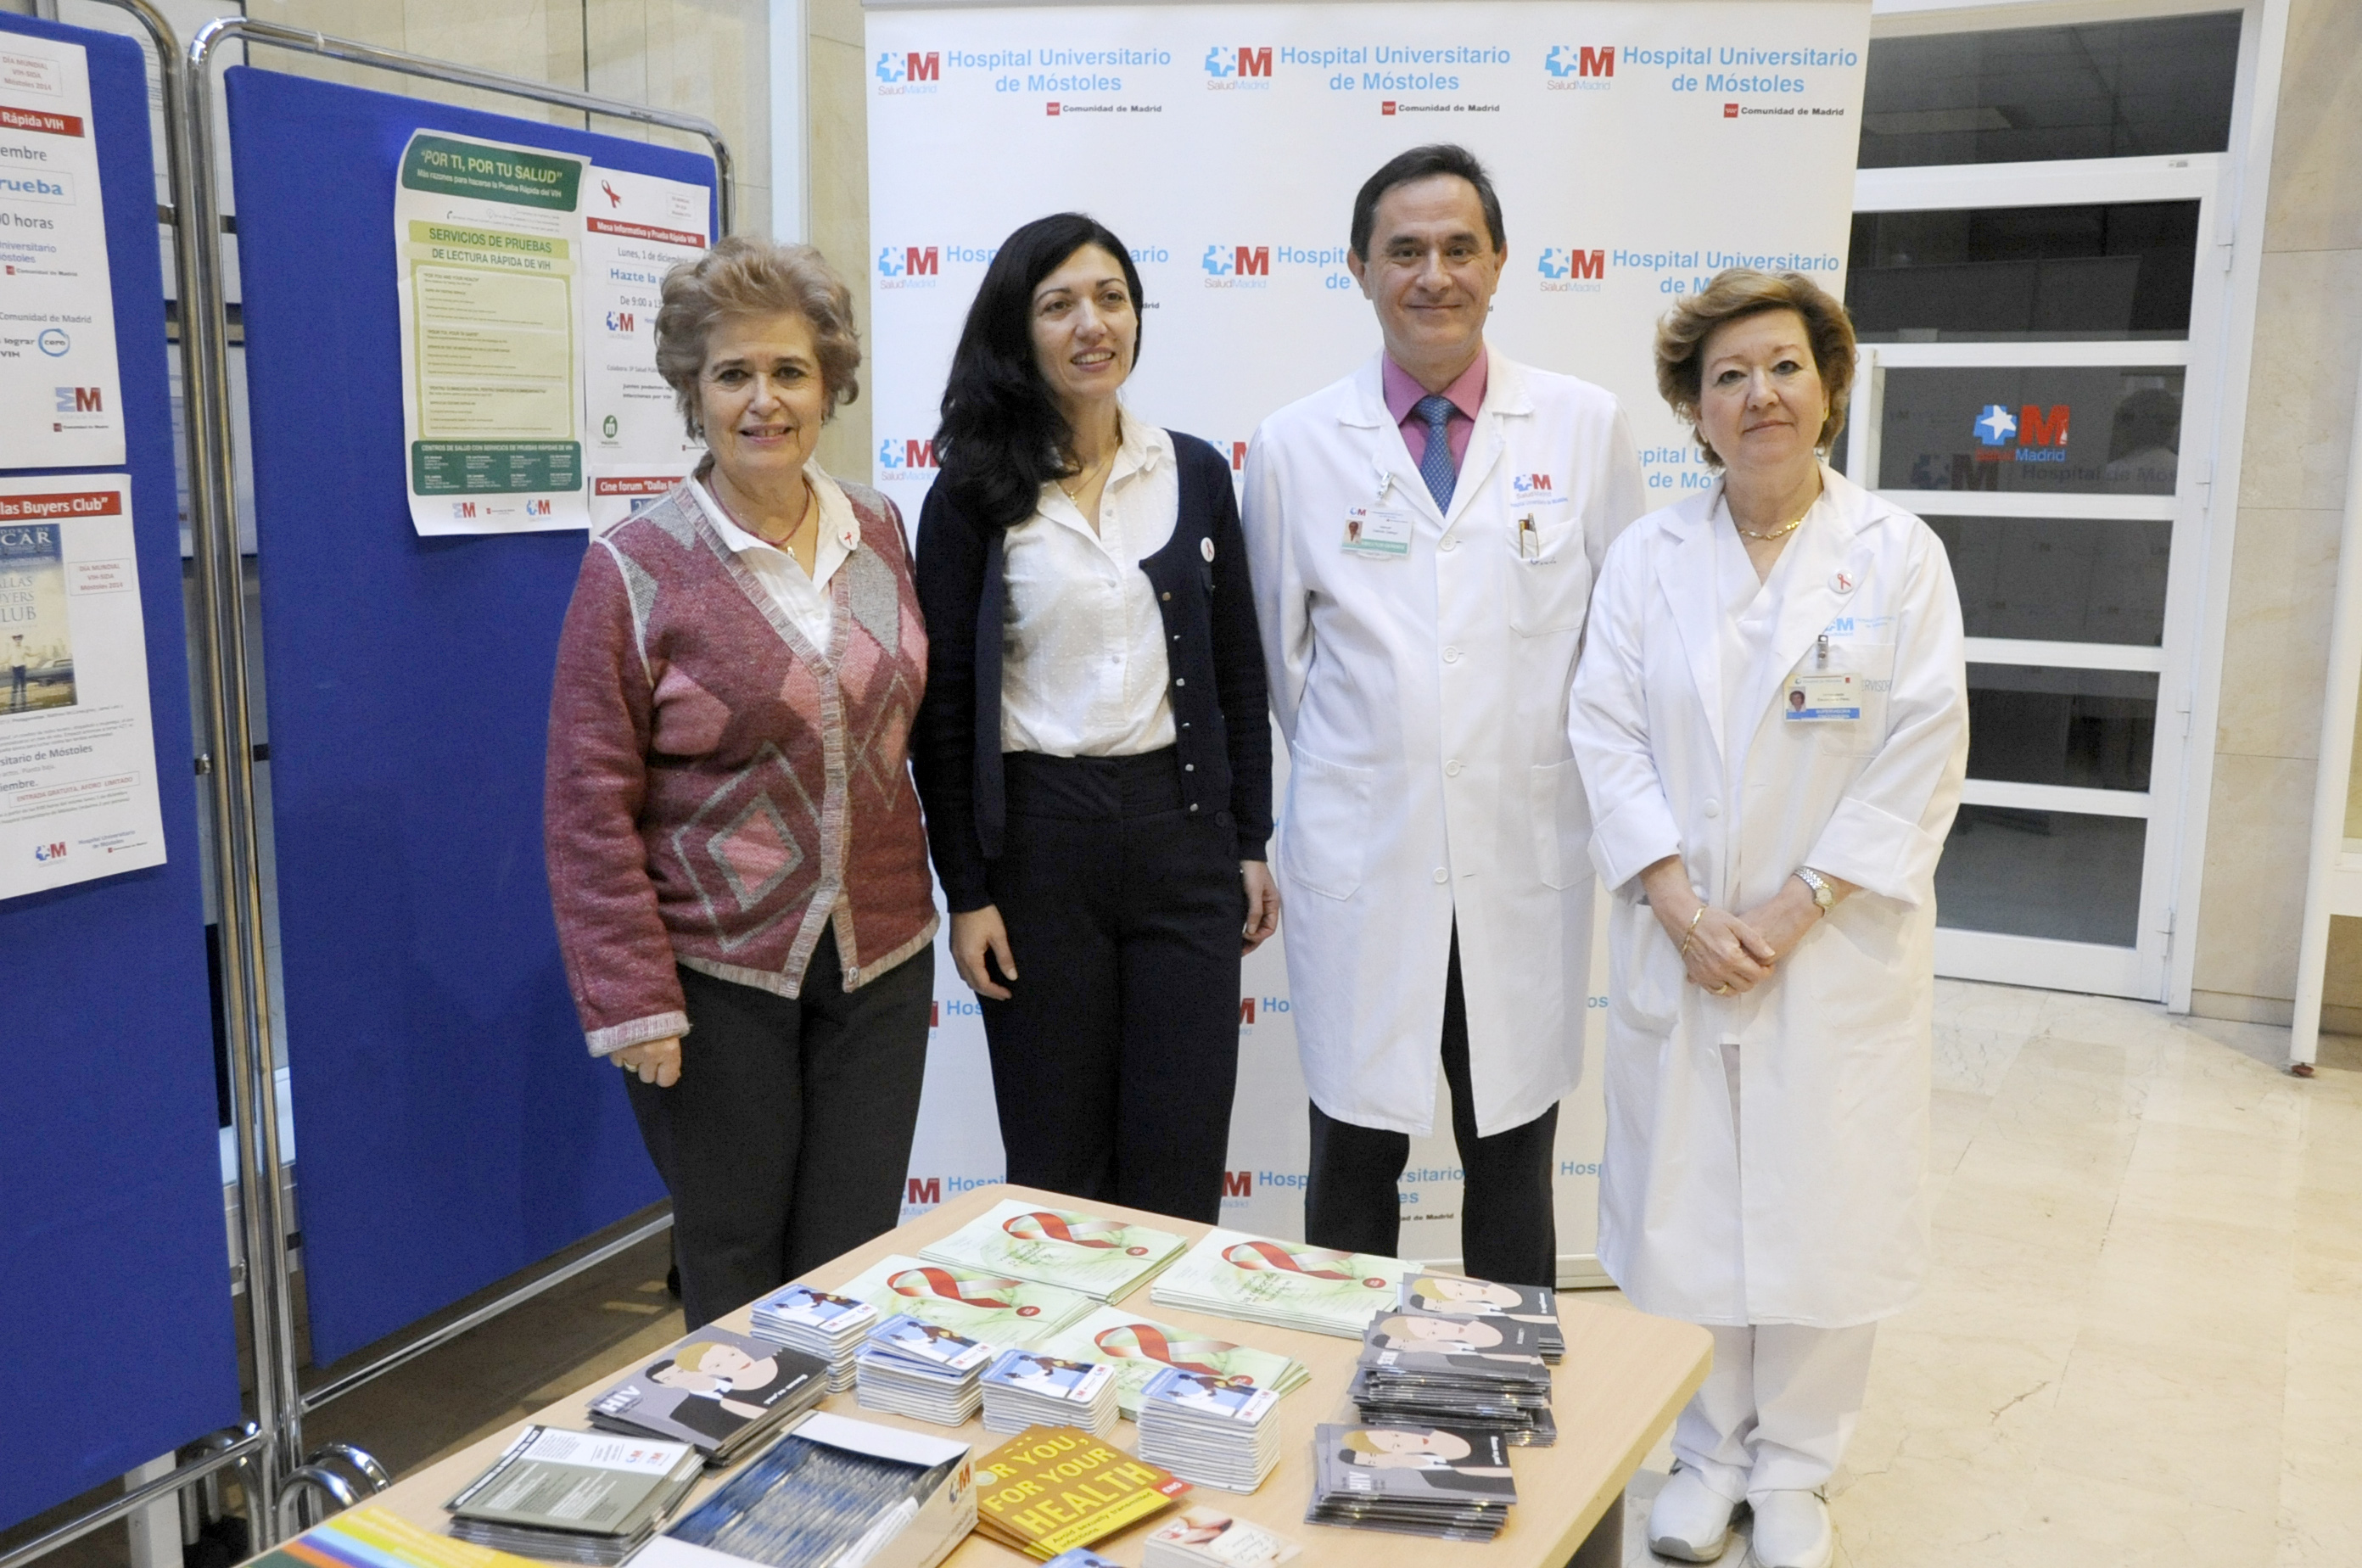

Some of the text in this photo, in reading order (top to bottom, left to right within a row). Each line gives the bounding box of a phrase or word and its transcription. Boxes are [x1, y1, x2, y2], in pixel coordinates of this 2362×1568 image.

[948, 48, 1171, 71] Hospital Universitario
[1239, 48, 1273, 76] M
[1281, 46, 1510, 69] Hospital Universitario
[1580, 46, 1615, 77] M
[1623, 46, 1857, 69] Hospital Universitario
[908, 53, 939, 81] M
[995, 74, 1122, 92] de Móstoles
[1207, 80, 1269, 91] SaludMadrid
[1329, 71, 1459, 90] de Móstoles
[1548, 80, 1611, 91] SaludMadrid
[1671, 73, 1805, 93] de Móstoles
[878, 84, 937, 95] SaludMadrid
[1398, 104, 1451, 112] Comunidad
[1453, 104, 1464, 112] de
[1741, 107, 1794, 115] Comunidad
[2, 112, 64, 131] Rápida VIH
[0, 146, 48, 161] embre
[451, 154, 466, 172] TI,
[468, 157, 494, 174] POR
[495, 162, 512, 176] TU
[0, 178, 64, 195] rueba
[417, 169, 429, 178] Más
[430, 173, 453, 182] razones
[454, 176, 467, 185] para
[468, 178, 491, 188] hacerse
[499, 182, 518, 192] Prueba
[520, 185, 540, 195] Rápida
[14, 214, 54, 229] horas
[429, 228, 551, 253] SERVICIOS DE PRUEBAS
[597, 221, 697, 244] Mesa Informativa Prueba Rápida VIH
[0, 241, 56, 253] niversitario
[618, 247, 641, 260] Lunes,
[642, 250, 646, 260] 1
[648, 251, 655, 260] de
[0, 254, 36, 263] óstoles
[433, 248, 551, 270] DE LECTURA RÁPIDA DE VIH
[906, 246, 938, 275] M
[1235, 246, 1269, 275] M
[1278, 246, 1348, 268] Hospit
[1571, 249, 1605, 279] M
[1613, 249, 1839, 272] Hospital Universitario
[610, 268, 645, 282] Hazte
[647, 272, 657, 283] la
[880, 278, 936, 289] SaludMadrid
[1205, 278, 1267, 288] SaludMadrid
[1325, 273, 1351, 288] de
[1540, 282, 1602, 292] SaludMadrid
[1660, 277, 1685, 294] de
[620, 295, 630, 305] De
[631, 297, 646, 307] 9:00
[49, 314, 60, 322] de
[63, 315, 92, 324] Madrid
[619, 312, 634, 332] M
[4, 338, 36, 347] lograr
[0, 350, 20, 358] VIH
[2019, 405, 2070, 445] M
[601, 482, 618, 492] Cine
[618, 481, 643, 491] forum
[1531, 473, 1552, 490] M
[1648, 473, 1673, 489] de
[23, 501, 70, 517] Buyers
[462, 502, 477, 518] M
[538, 499, 551, 515] M
[2, 531, 52, 546] CAR
[1, 606, 36, 623] LUB
[1836, 618, 1855, 631] M
[0, 744, 93, 765] sitario de Móstoles
[0, 779, 39, 792] iembre.
[17, 792, 47, 803] ENTRADA
[81, 782, 102, 791] AFORO
[105, 777, 133, 787] LIMITADO
[50, 842, 67, 859] M
[1259, 1171, 1308, 1190] Hosp
[1397, 1168, 1465, 1184] rsitario
[909, 1178, 940, 1203] M
[599, 1385, 641, 1412] HIV
[1010, 1436, 1089, 1465] YOU,
[982, 1447, 1118, 1512] FOR YOUR
[1161, 1481, 1183, 1494] ENG
[1011, 1461, 1158, 1536] HEALTH
[1053, 1492, 1154, 1544] Avoid sexually transmitted
[1061, 1527, 1100, 1548] infections
